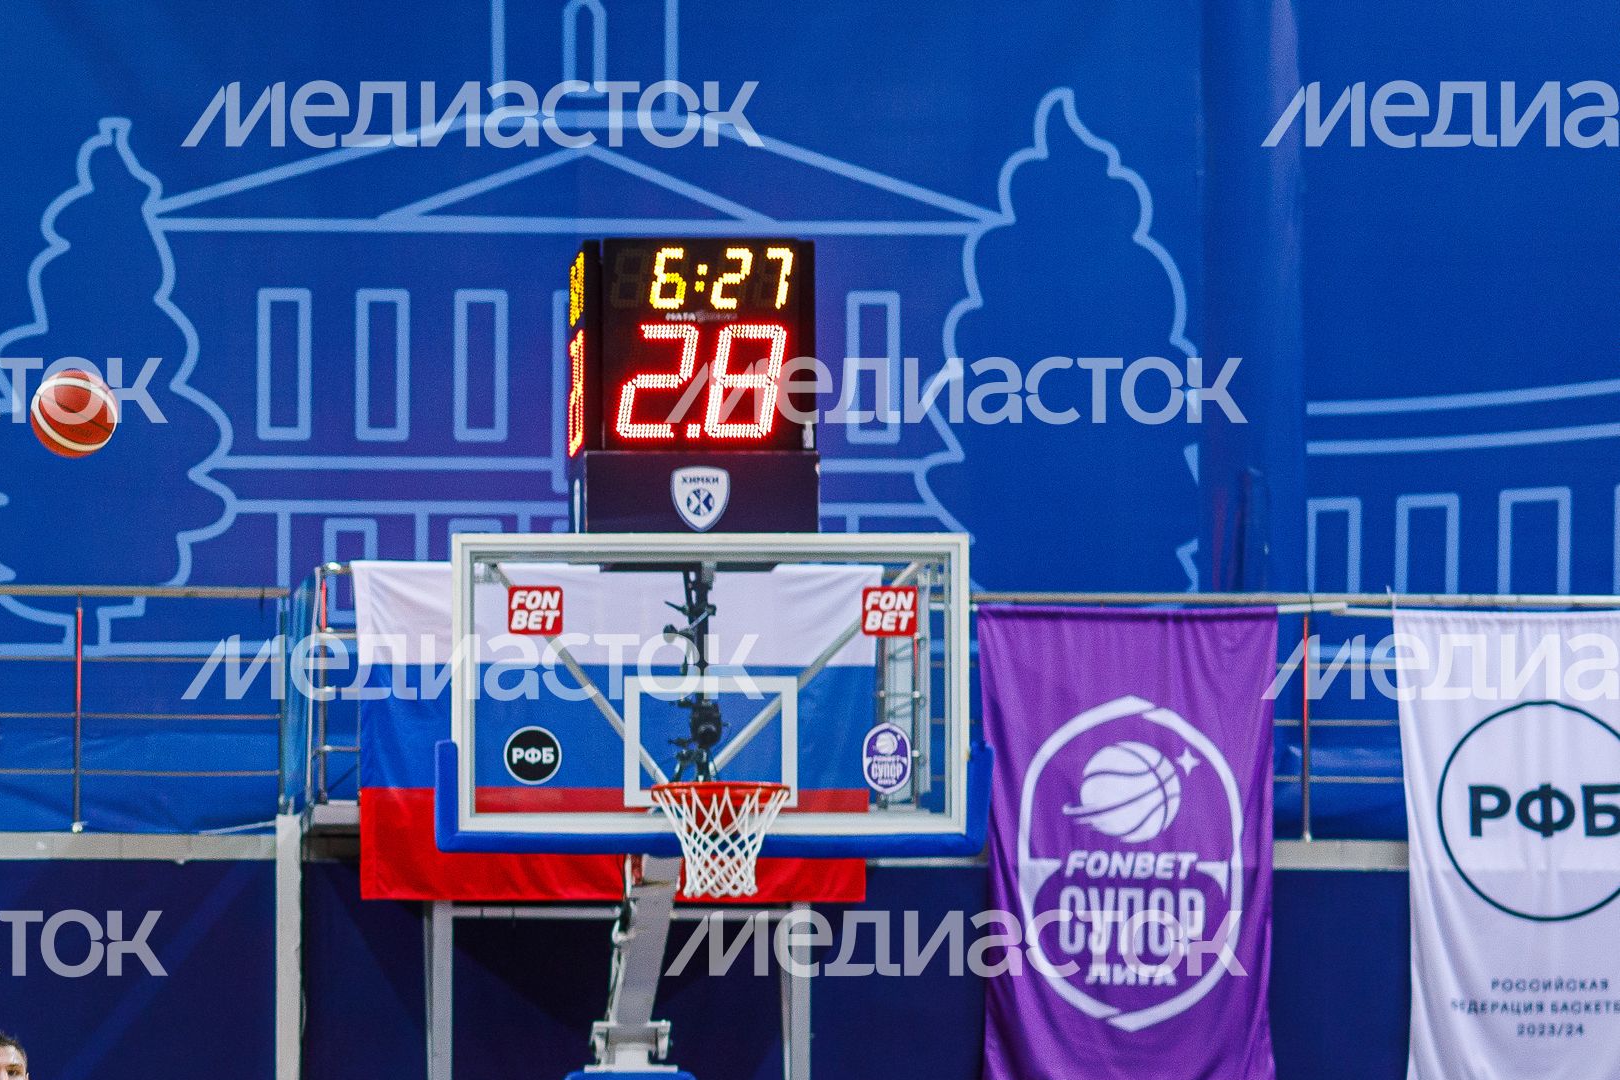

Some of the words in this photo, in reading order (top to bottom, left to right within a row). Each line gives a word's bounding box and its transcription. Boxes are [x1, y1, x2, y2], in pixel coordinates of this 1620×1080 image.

[650, 248, 793, 309] 6:27
[616, 324, 786, 438] 2.8
[510, 590, 561, 610] FON
[864, 591, 915, 611] FON
[510, 609, 561, 631] BET
[864, 610, 914, 632] BET
[511, 747, 555, 765] РФБ
[1468, 783, 1620, 838] РФБ
[1064, 850, 1199, 880] FONBET
[1058, 885, 1206, 957] СУПЕР
[1084, 962, 1178, 986] ЛИГА
[1491, 975, 1609, 993] РОССИЙСКАЯ
[1515, 1022, 1584, 1037] 2023/24
